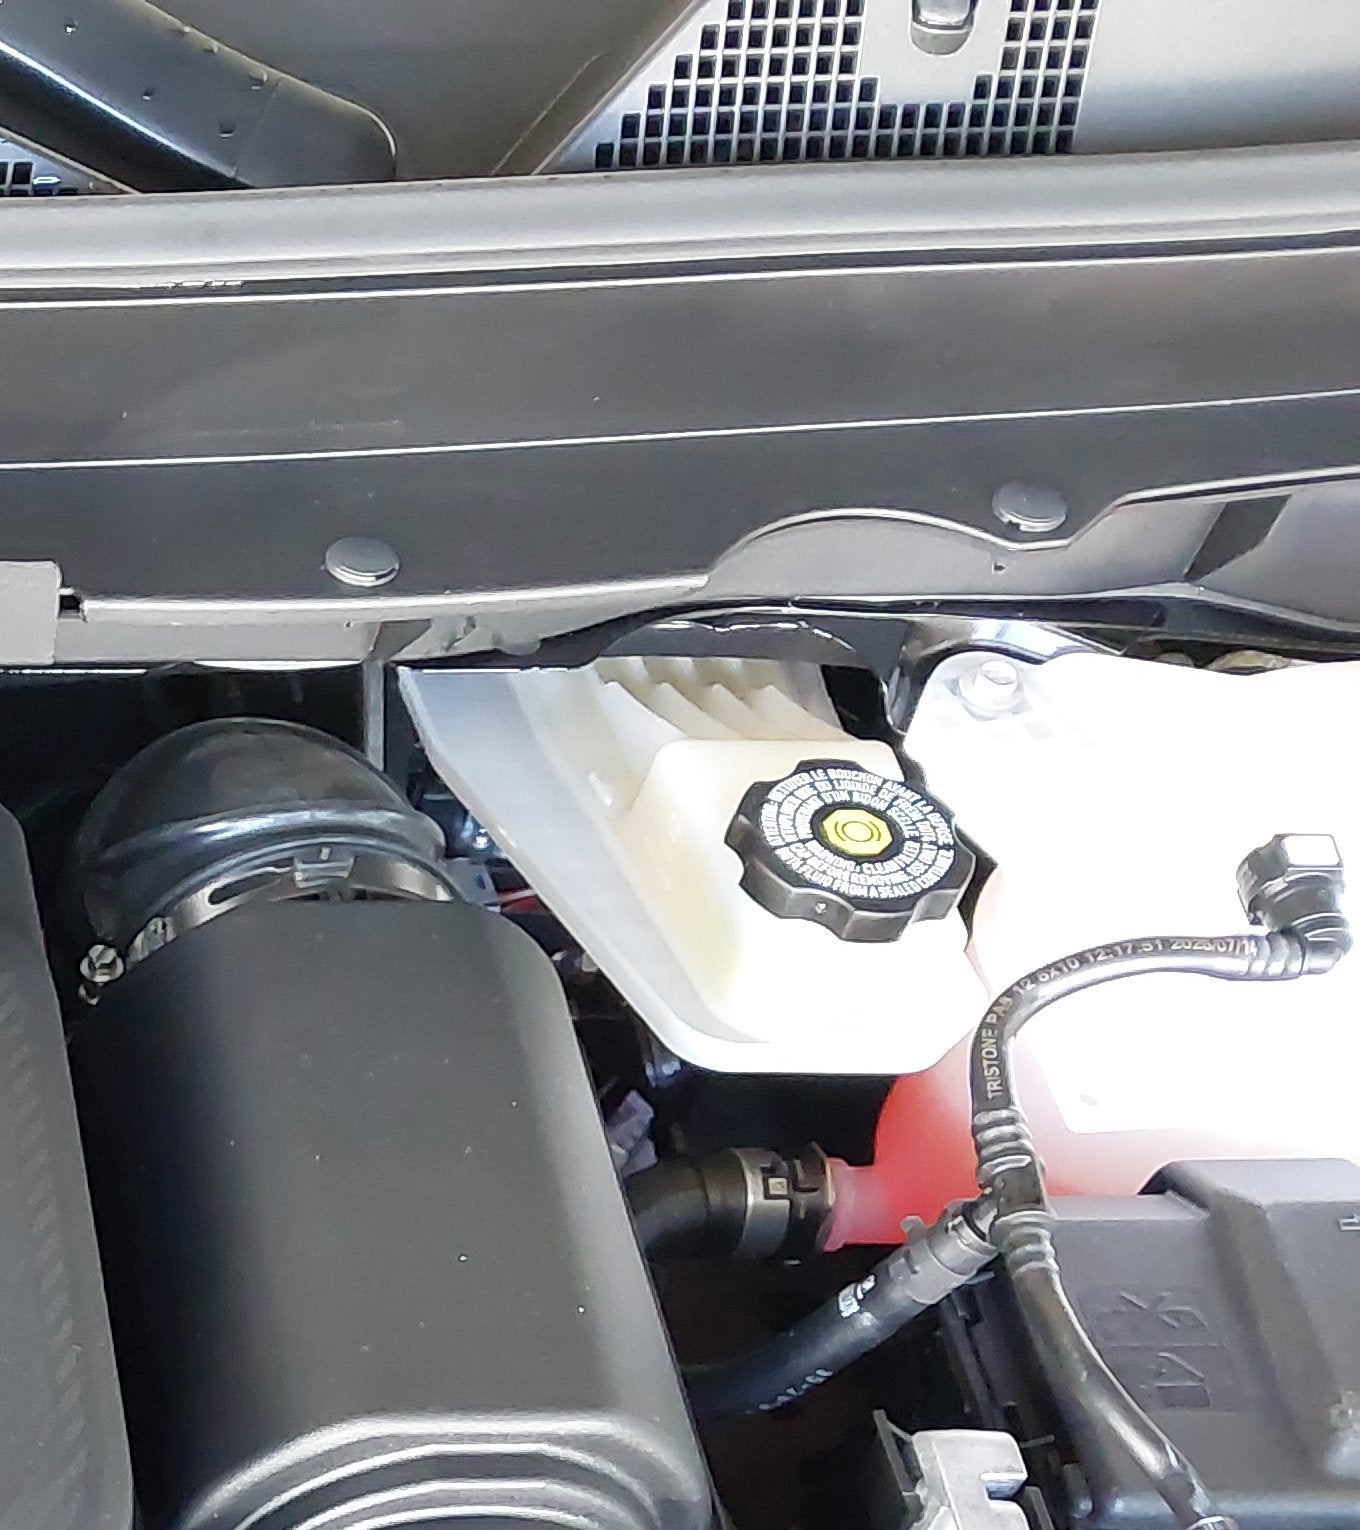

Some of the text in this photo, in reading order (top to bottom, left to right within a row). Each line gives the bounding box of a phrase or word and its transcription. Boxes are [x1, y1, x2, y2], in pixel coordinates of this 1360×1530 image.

[808, 769, 827, 780] LE
[825, 768, 884, 786] BOUCHON
[882, 779, 921, 803] AVANT
[914, 799, 935, 813] LA
[812, 780, 833, 792] DU
[877, 788, 896, 801] DE
[891, 797, 925, 821] FREIN
[795, 863, 834, 888] FLUID
[830, 878, 867, 897] FROM
[868, 885, 879, 897] A
[876, 880, 924, 897] SEALED
[862, 859, 902, 874] CLEAN
[904, 859, 929, 877] USE
[981, 1028, 1003, 1100] TRISTONE
